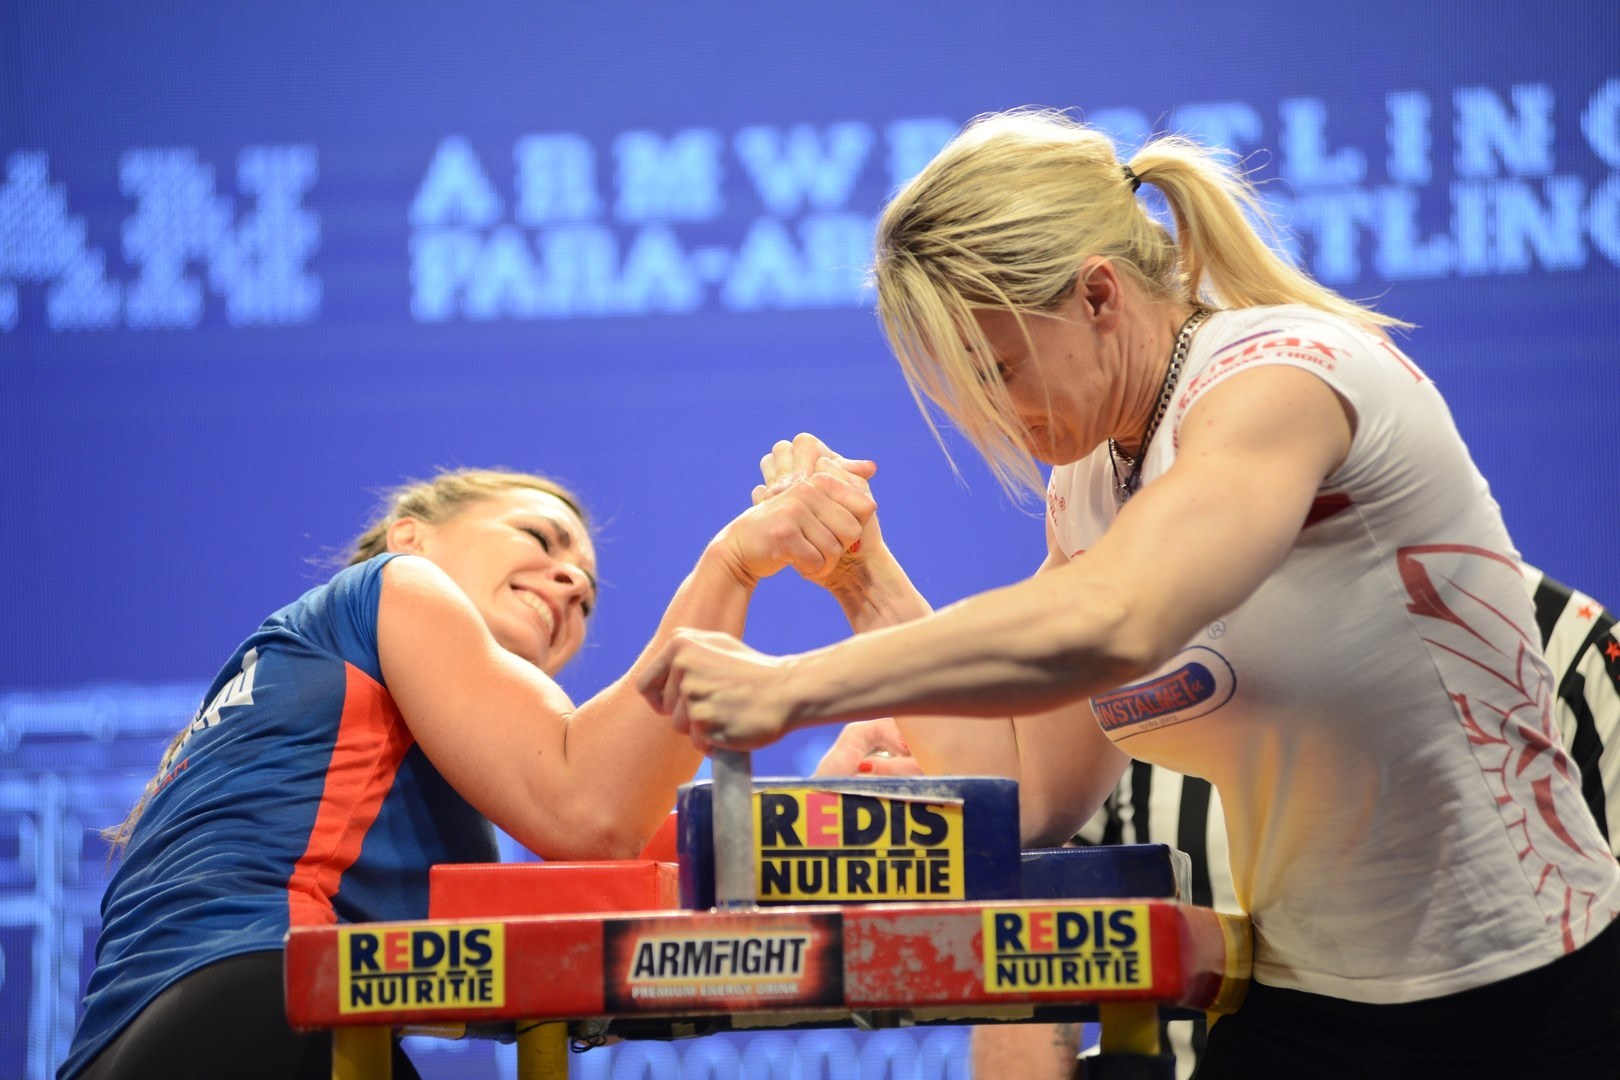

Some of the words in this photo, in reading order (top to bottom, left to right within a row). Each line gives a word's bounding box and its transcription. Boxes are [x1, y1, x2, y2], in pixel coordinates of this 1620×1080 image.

[761, 792, 949, 848] REDIS
[761, 848, 950, 895] NUTRITIE
[350, 927, 493, 971] REDIS
[995, 909, 1137, 952] REDIS
[633, 938, 807, 978] ARMFIGHT
[996, 952, 1140, 988] NUTRITIE
[351, 970, 493, 1008] NUTRITIE
[631, 985, 697, 999] PREMIUM
[701, 983, 752, 997] ENERGY
[756, 982, 799, 995] DRINK
